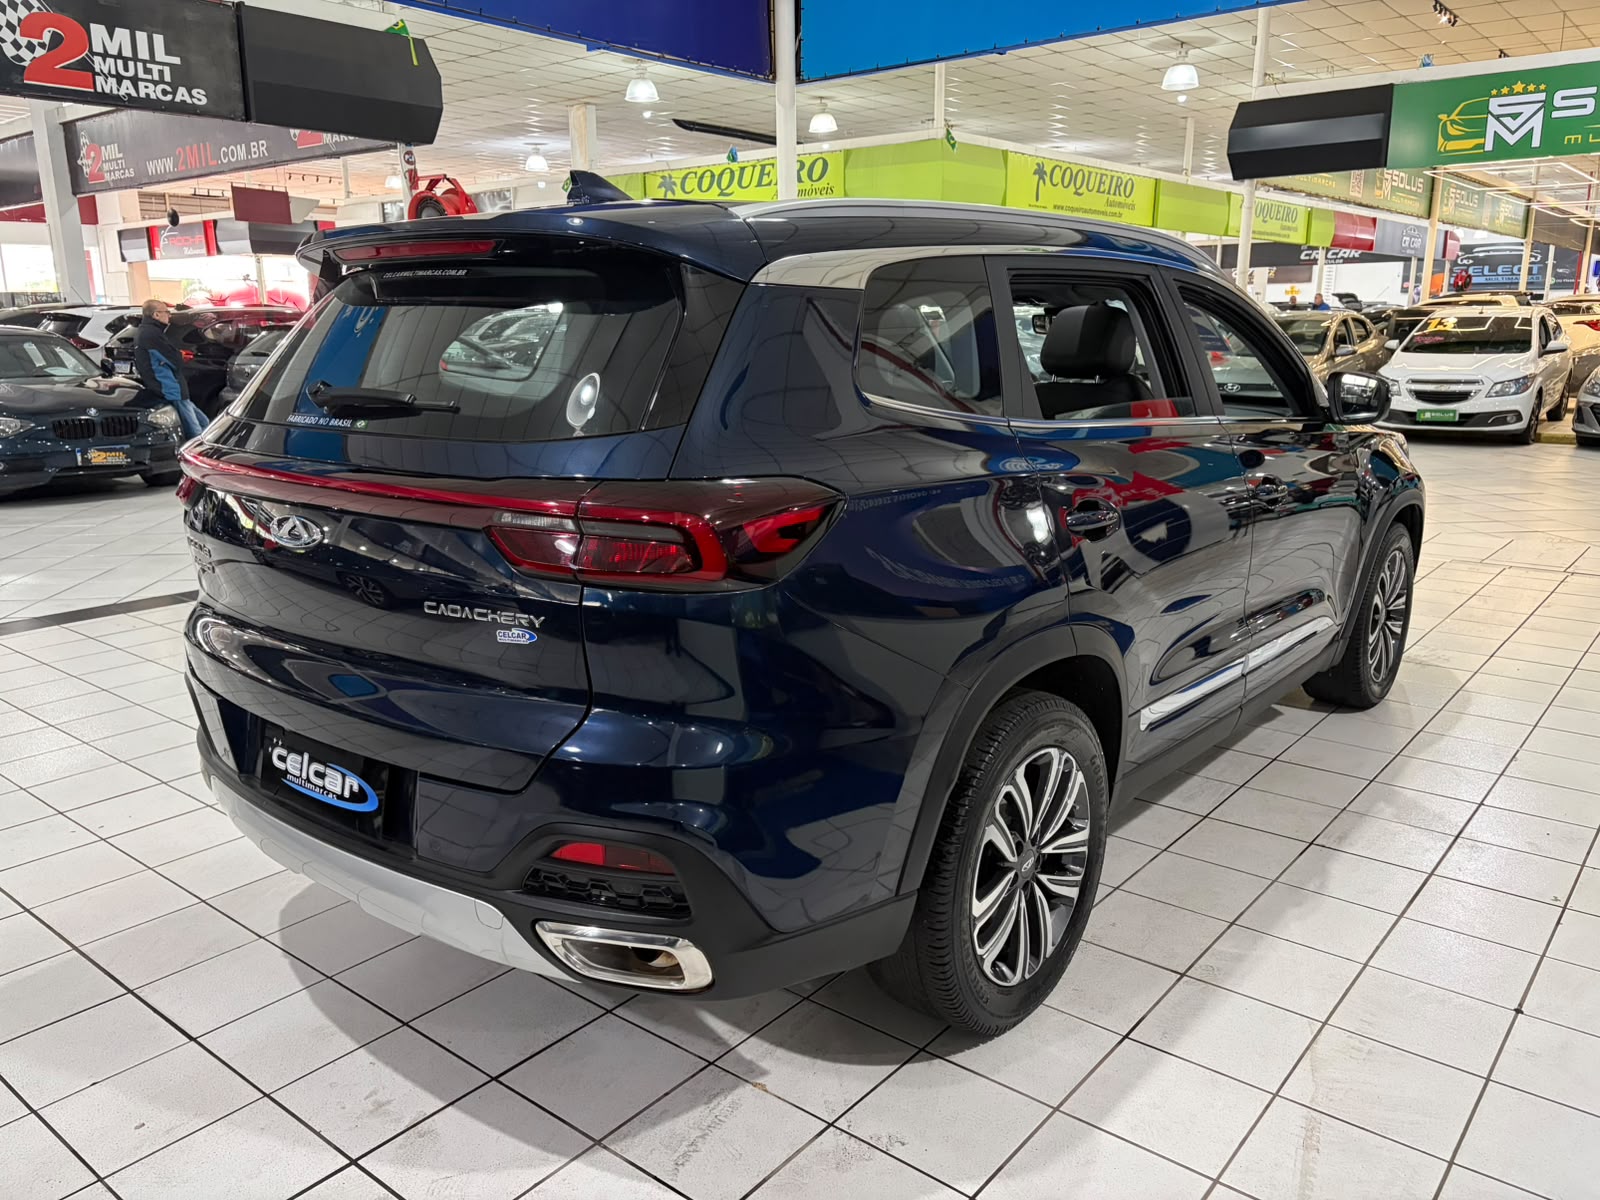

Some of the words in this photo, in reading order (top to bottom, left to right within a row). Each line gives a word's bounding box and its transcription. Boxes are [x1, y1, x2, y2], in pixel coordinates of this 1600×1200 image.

[19, 11, 95, 92] 2
[89, 23, 182, 66] MIL
[94, 55, 172, 83] MULTI
[95, 74, 208, 106] MARCAS
[86, 144, 105, 184] 2
[101, 143, 124, 160] MIL
[103, 159, 126, 170] MULTI
[146, 139, 269, 177] WWW.2MIL.COM.BR
[103, 168, 136, 180] MARCAS
[680, 156, 829, 197] COQUERO
[1049, 164, 1136, 199] COQUEIRO
[1392, 169, 1425, 194] SOLUS
[1255, 200, 1298, 224] OQUEIRO
[1300, 250, 1320, 260] CR
[1326, 249, 1362, 259] CAR
[286, 414, 319, 425] FABRICADO
[318, 417, 329, 426] NO
[329, 418, 353, 428] BRASIL
[497, 631, 527, 640] CELCAR
[271, 746, 360, 799] celcar
[286, 773, 338, 801] multimarcas
